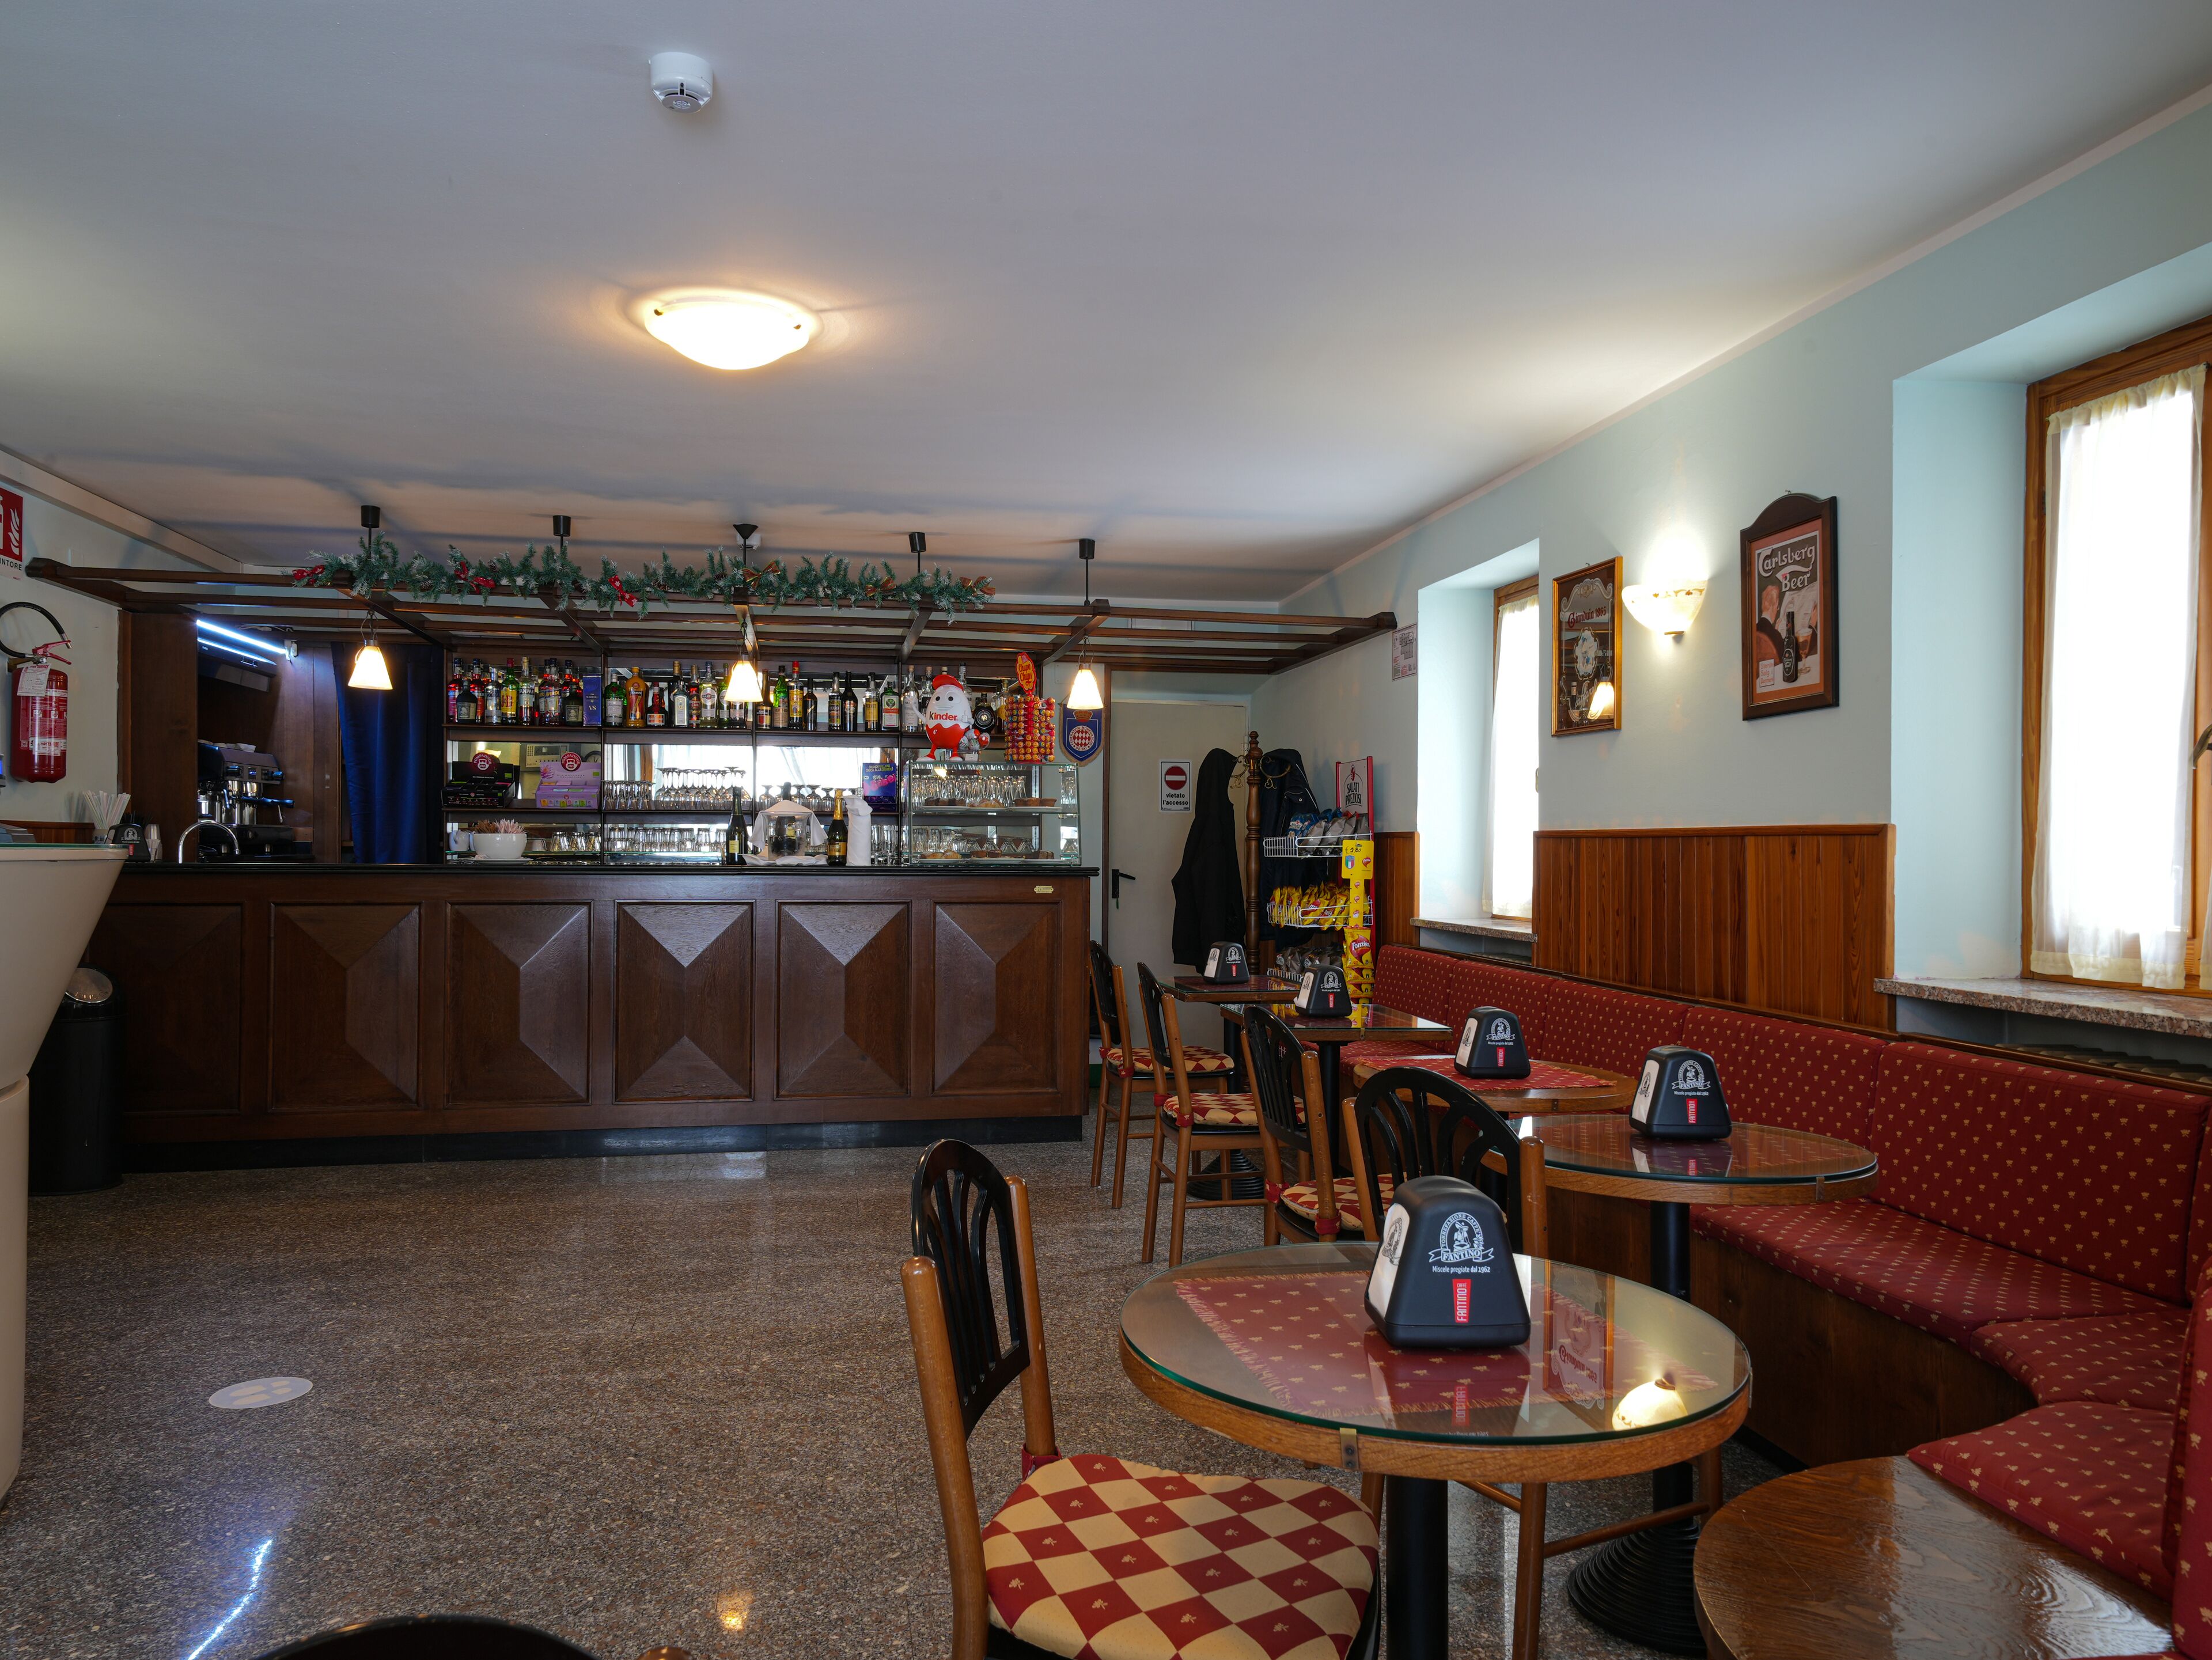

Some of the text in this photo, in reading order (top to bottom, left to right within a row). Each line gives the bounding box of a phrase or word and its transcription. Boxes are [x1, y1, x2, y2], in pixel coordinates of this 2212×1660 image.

[1759, 544, 1815, 577] Carlsberg
[1781, 571, 1810, 592] Beer
[1568, 606, 1606, 628] Gianduia 1865
[1018, 664, 1031, 672] Chupa
[1020, 672, 1032, 682] Chups
[474, 753, 492, 764] POMPADOUR
[562, 754, 581, 764] POMPADOUR
[1347, 782, 1359, 794] SALATI
[1346, 793, 1361, 806] PREZIOSI
[1441, 1214, 1466, 1248] TORREFAZIONE
[1442, 1249, 1482, 1261] FANTINO
[1450, 1266, 1469, 1274] pregiate
[1457, 1287, 1467, 1321] FANTINO
